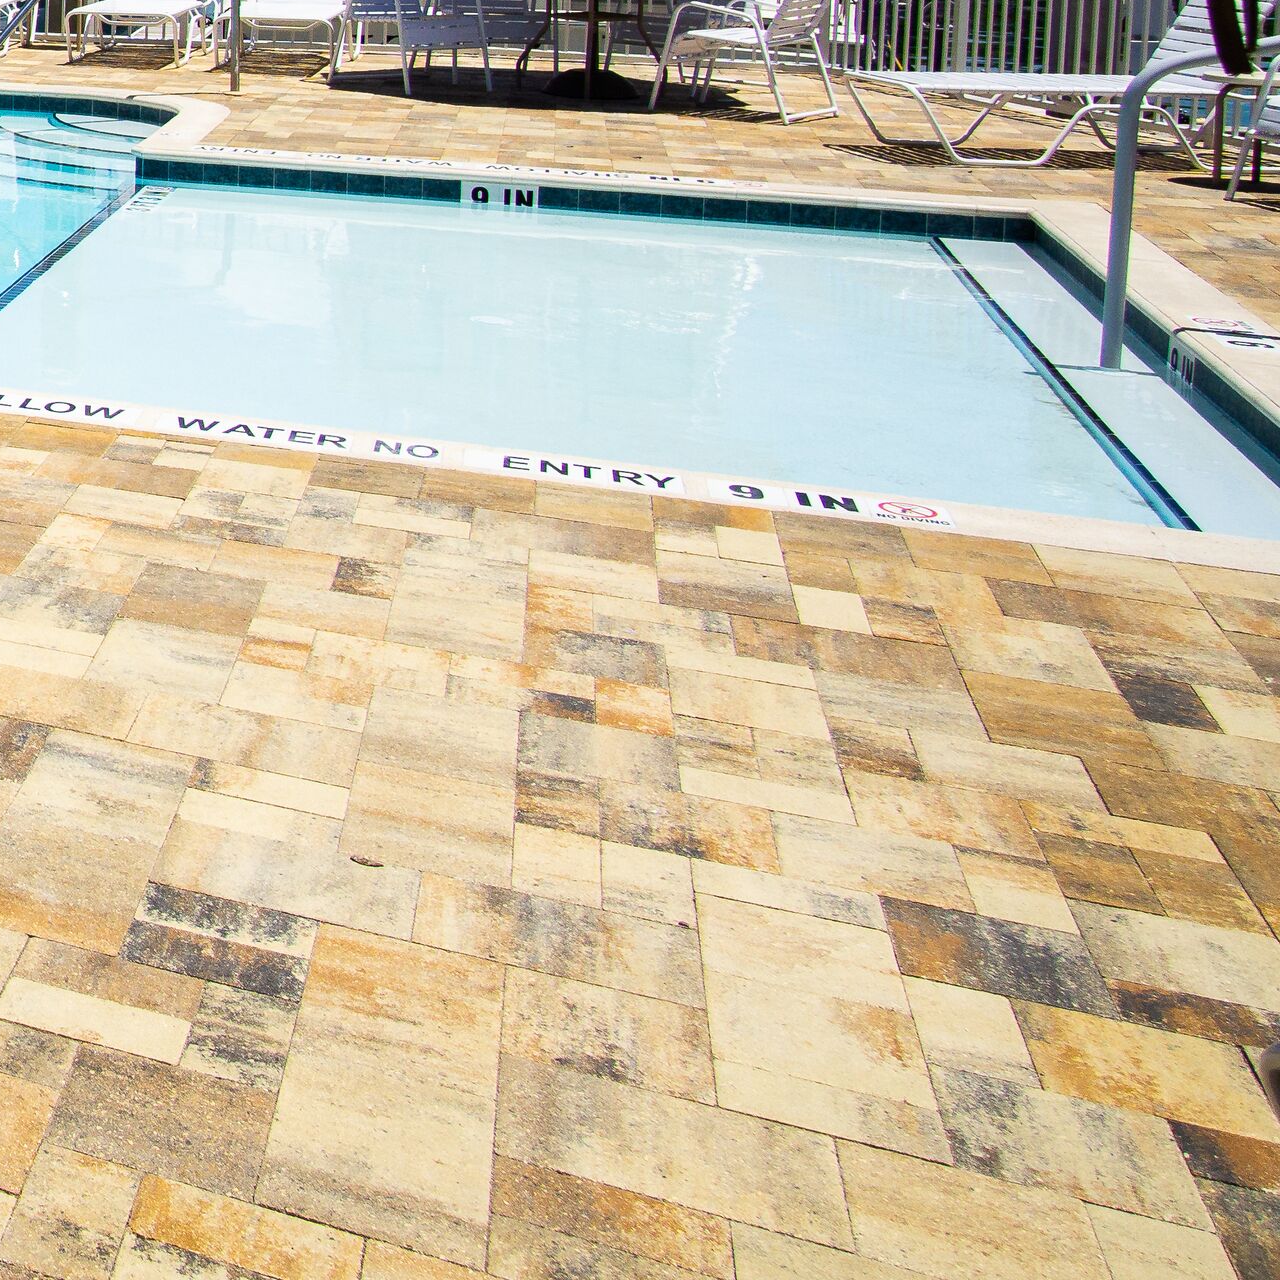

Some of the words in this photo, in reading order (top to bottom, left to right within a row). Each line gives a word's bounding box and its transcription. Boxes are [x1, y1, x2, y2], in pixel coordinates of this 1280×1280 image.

[470, 185, 489, 204] 9
[503, 188, 534, 207] IN
[176, 415, 349, 450] WATER
[372, 438, 440, 460] NO
[502, 454, 676, 490] ENTRY
[729, 484, 766, 500] 9
[794, 490, 860, 514] IN
[876, 512, 897, 520] NO
[900, 515, 951, 526] DIVING
